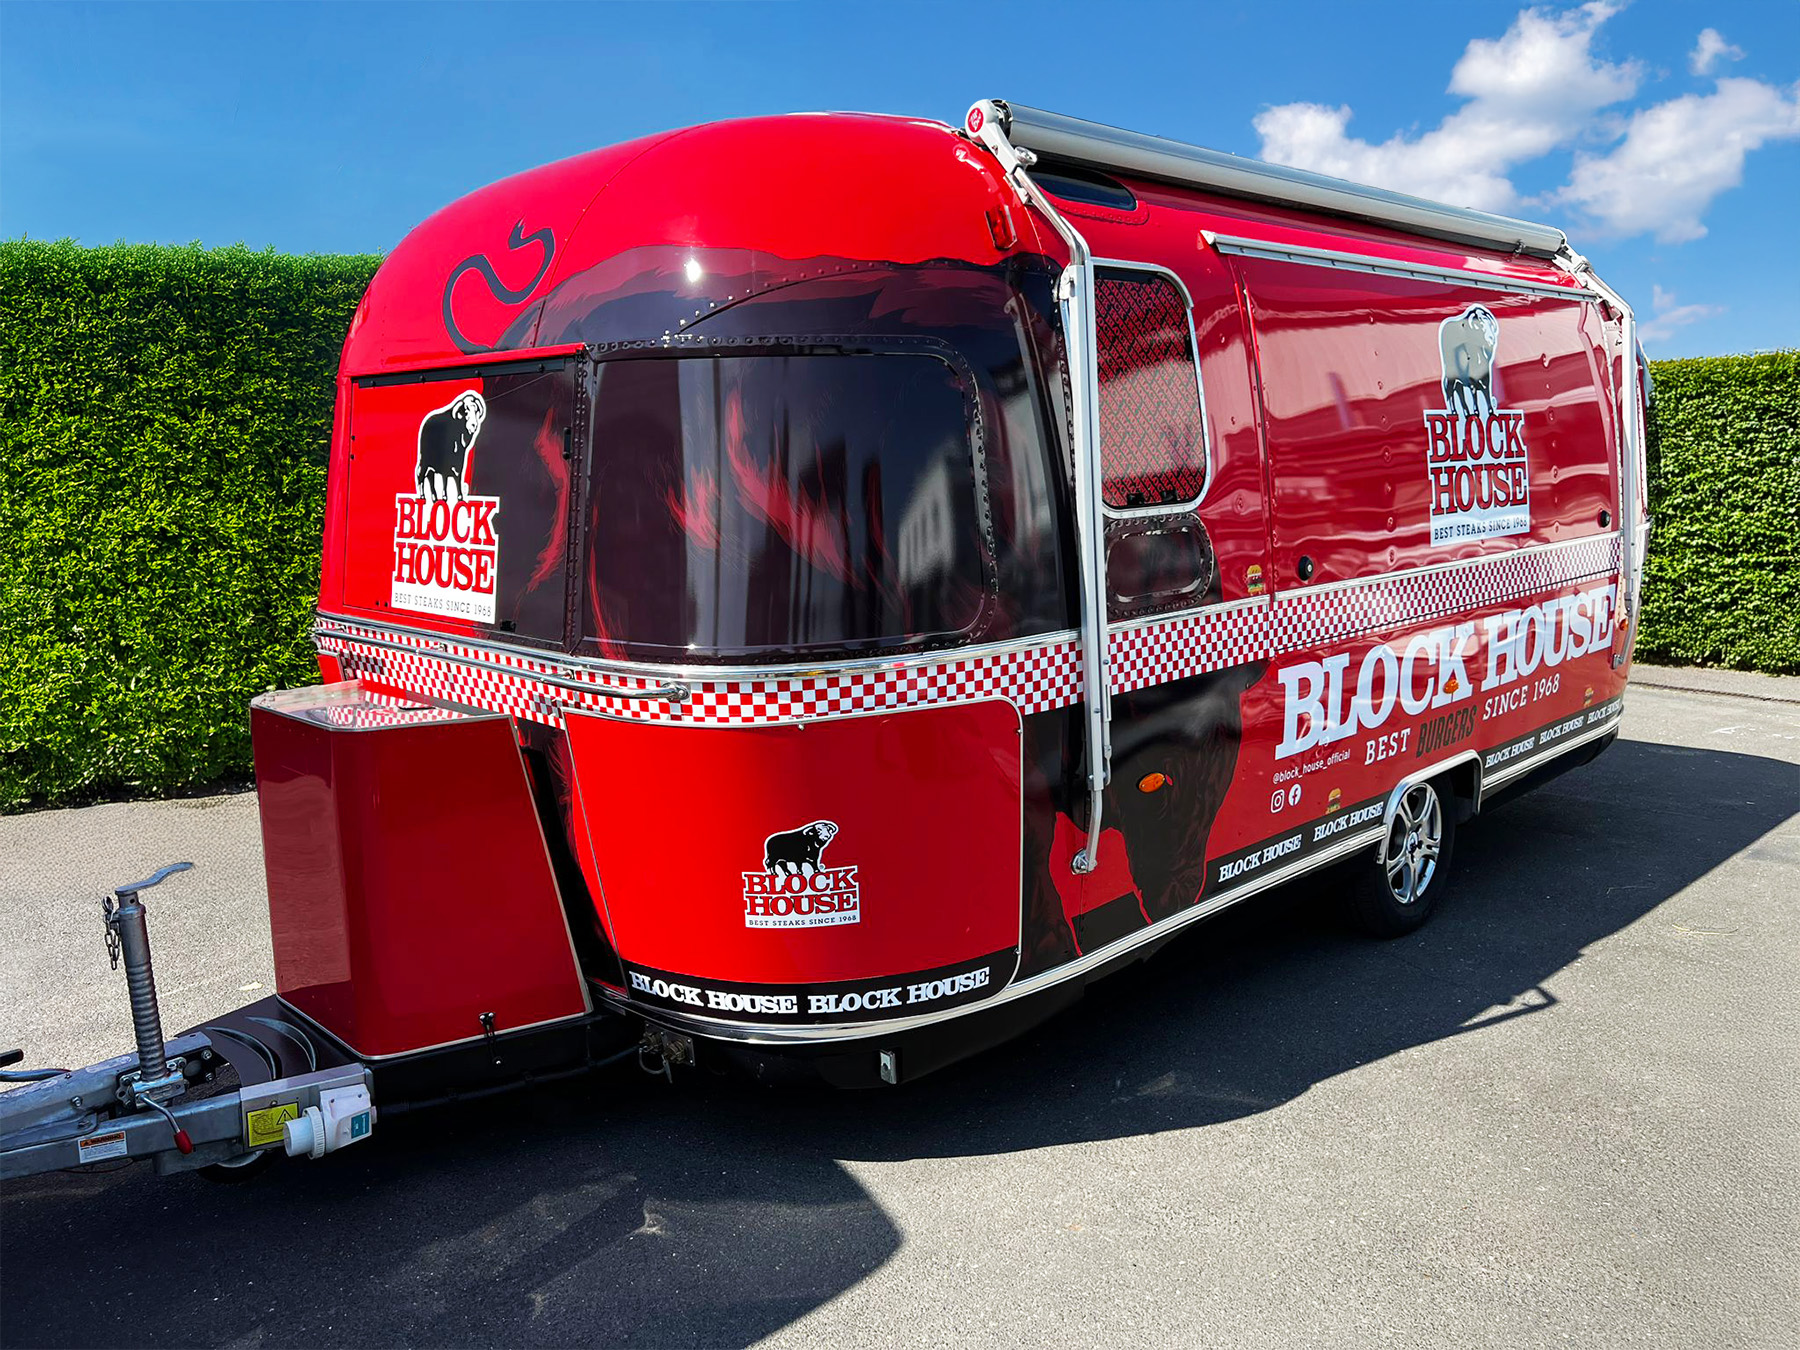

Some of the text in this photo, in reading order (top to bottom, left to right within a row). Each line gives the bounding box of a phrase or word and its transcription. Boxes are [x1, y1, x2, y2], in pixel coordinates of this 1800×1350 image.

[1426, 413, 1525, 463] BLOCK
[1430, 461, 1527, 516] HOUSE
[397, 497, 496, 546] BLOCK
[1434, 526, 1453, 540] BEST
[1457, 522, 1486, 536] STEAKS
[1489, 518, 1510, 532] SINCE
[395, 542, 495, 594] HOUSE
[395, 592, 492, 617] BEST STEAKS SINCE 1968
[1275, 583, 1616, 760] BLOCK HOUSE
[1364, 673, 1560, 765] BEST BURGERS SINCE 1968
[1485, 750, 1511, 768] BLOCK
[1511, 737, 1535, 757] HOUSE
[1539, 724, 1563, 744] BLOCK
[1562, 716, 1584, 735] HOUSE
[1587, 709, 1606, 724] BLOCK
[1273, 748, 1350, 784] @block_house_official
[1218, 802, 1383, 882] BLOCK HOUSE BLOCK HOUSE
[744, 867, 857, 895] BLOCK
[745, 890, 857, 916] HOUSE
[809, 917, 835, 925] SINCE
[629, 967, 990, 1013] BLOCK HOUSE BLOCK HOUSE
